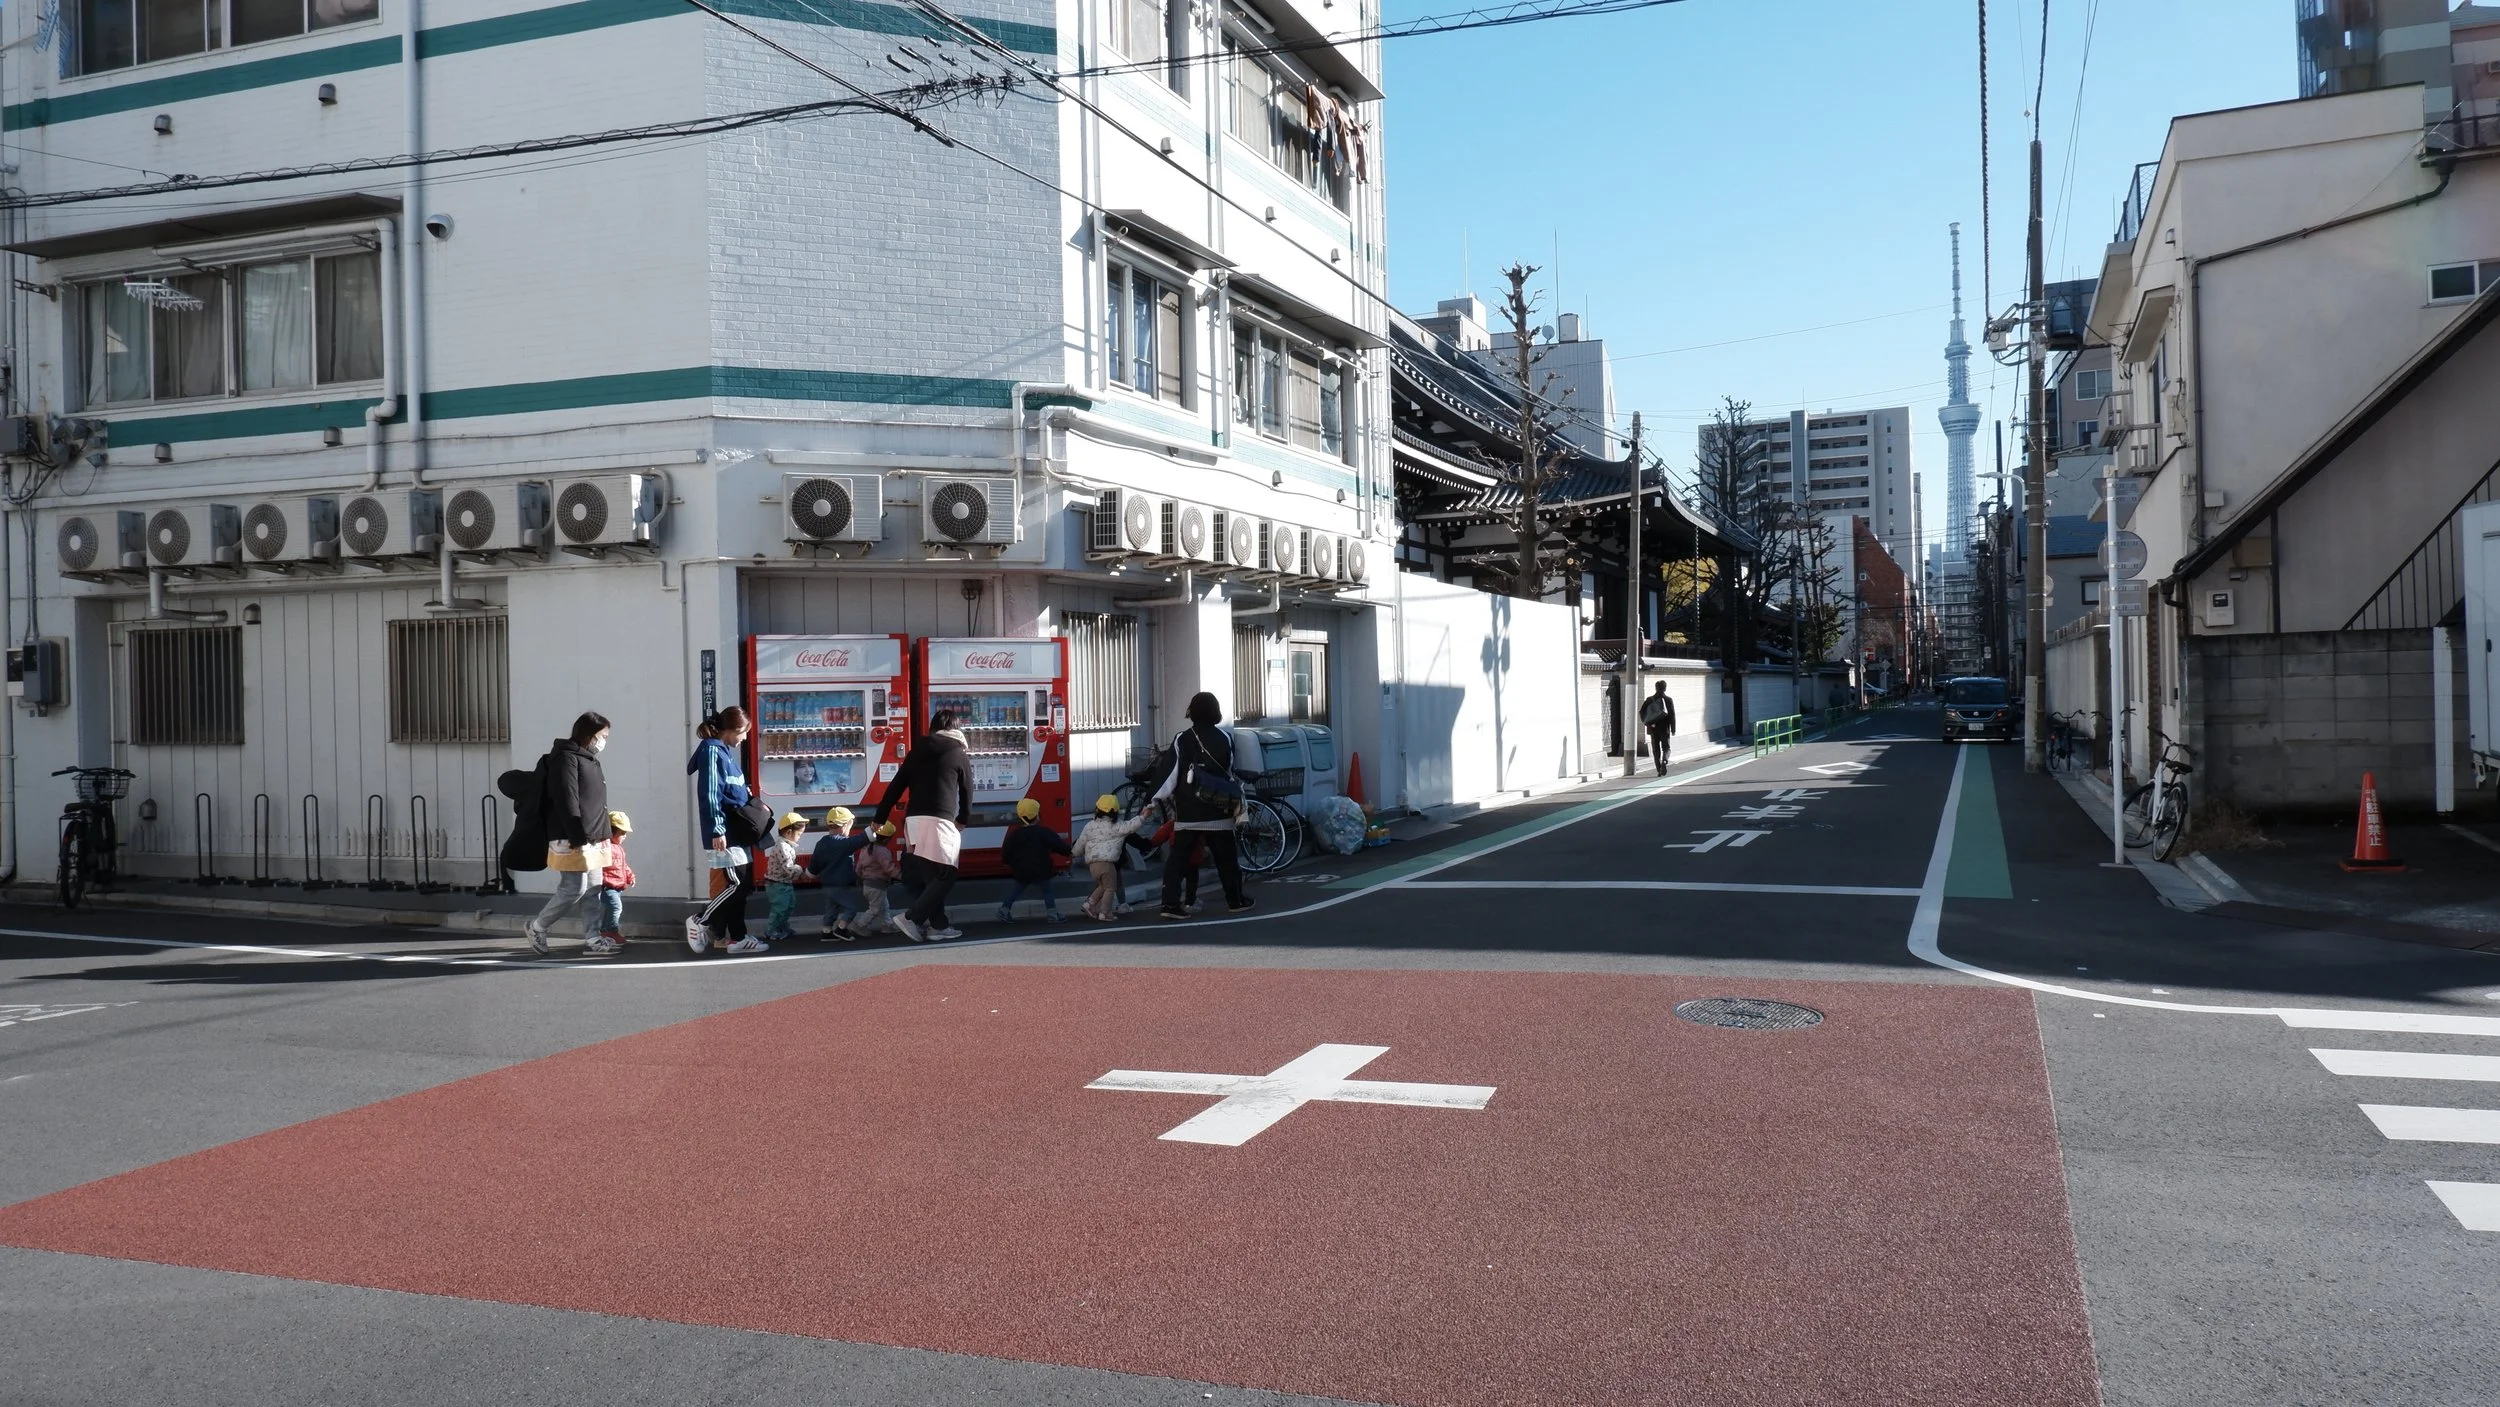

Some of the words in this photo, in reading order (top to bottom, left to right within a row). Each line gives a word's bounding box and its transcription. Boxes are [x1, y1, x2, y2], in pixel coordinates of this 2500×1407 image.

[796, 649, 852, 668] Coca-Cola
[965, 651, 1016, 669] Coca-Cola
[2366, 802, 2383, 846] 駐車禁止
